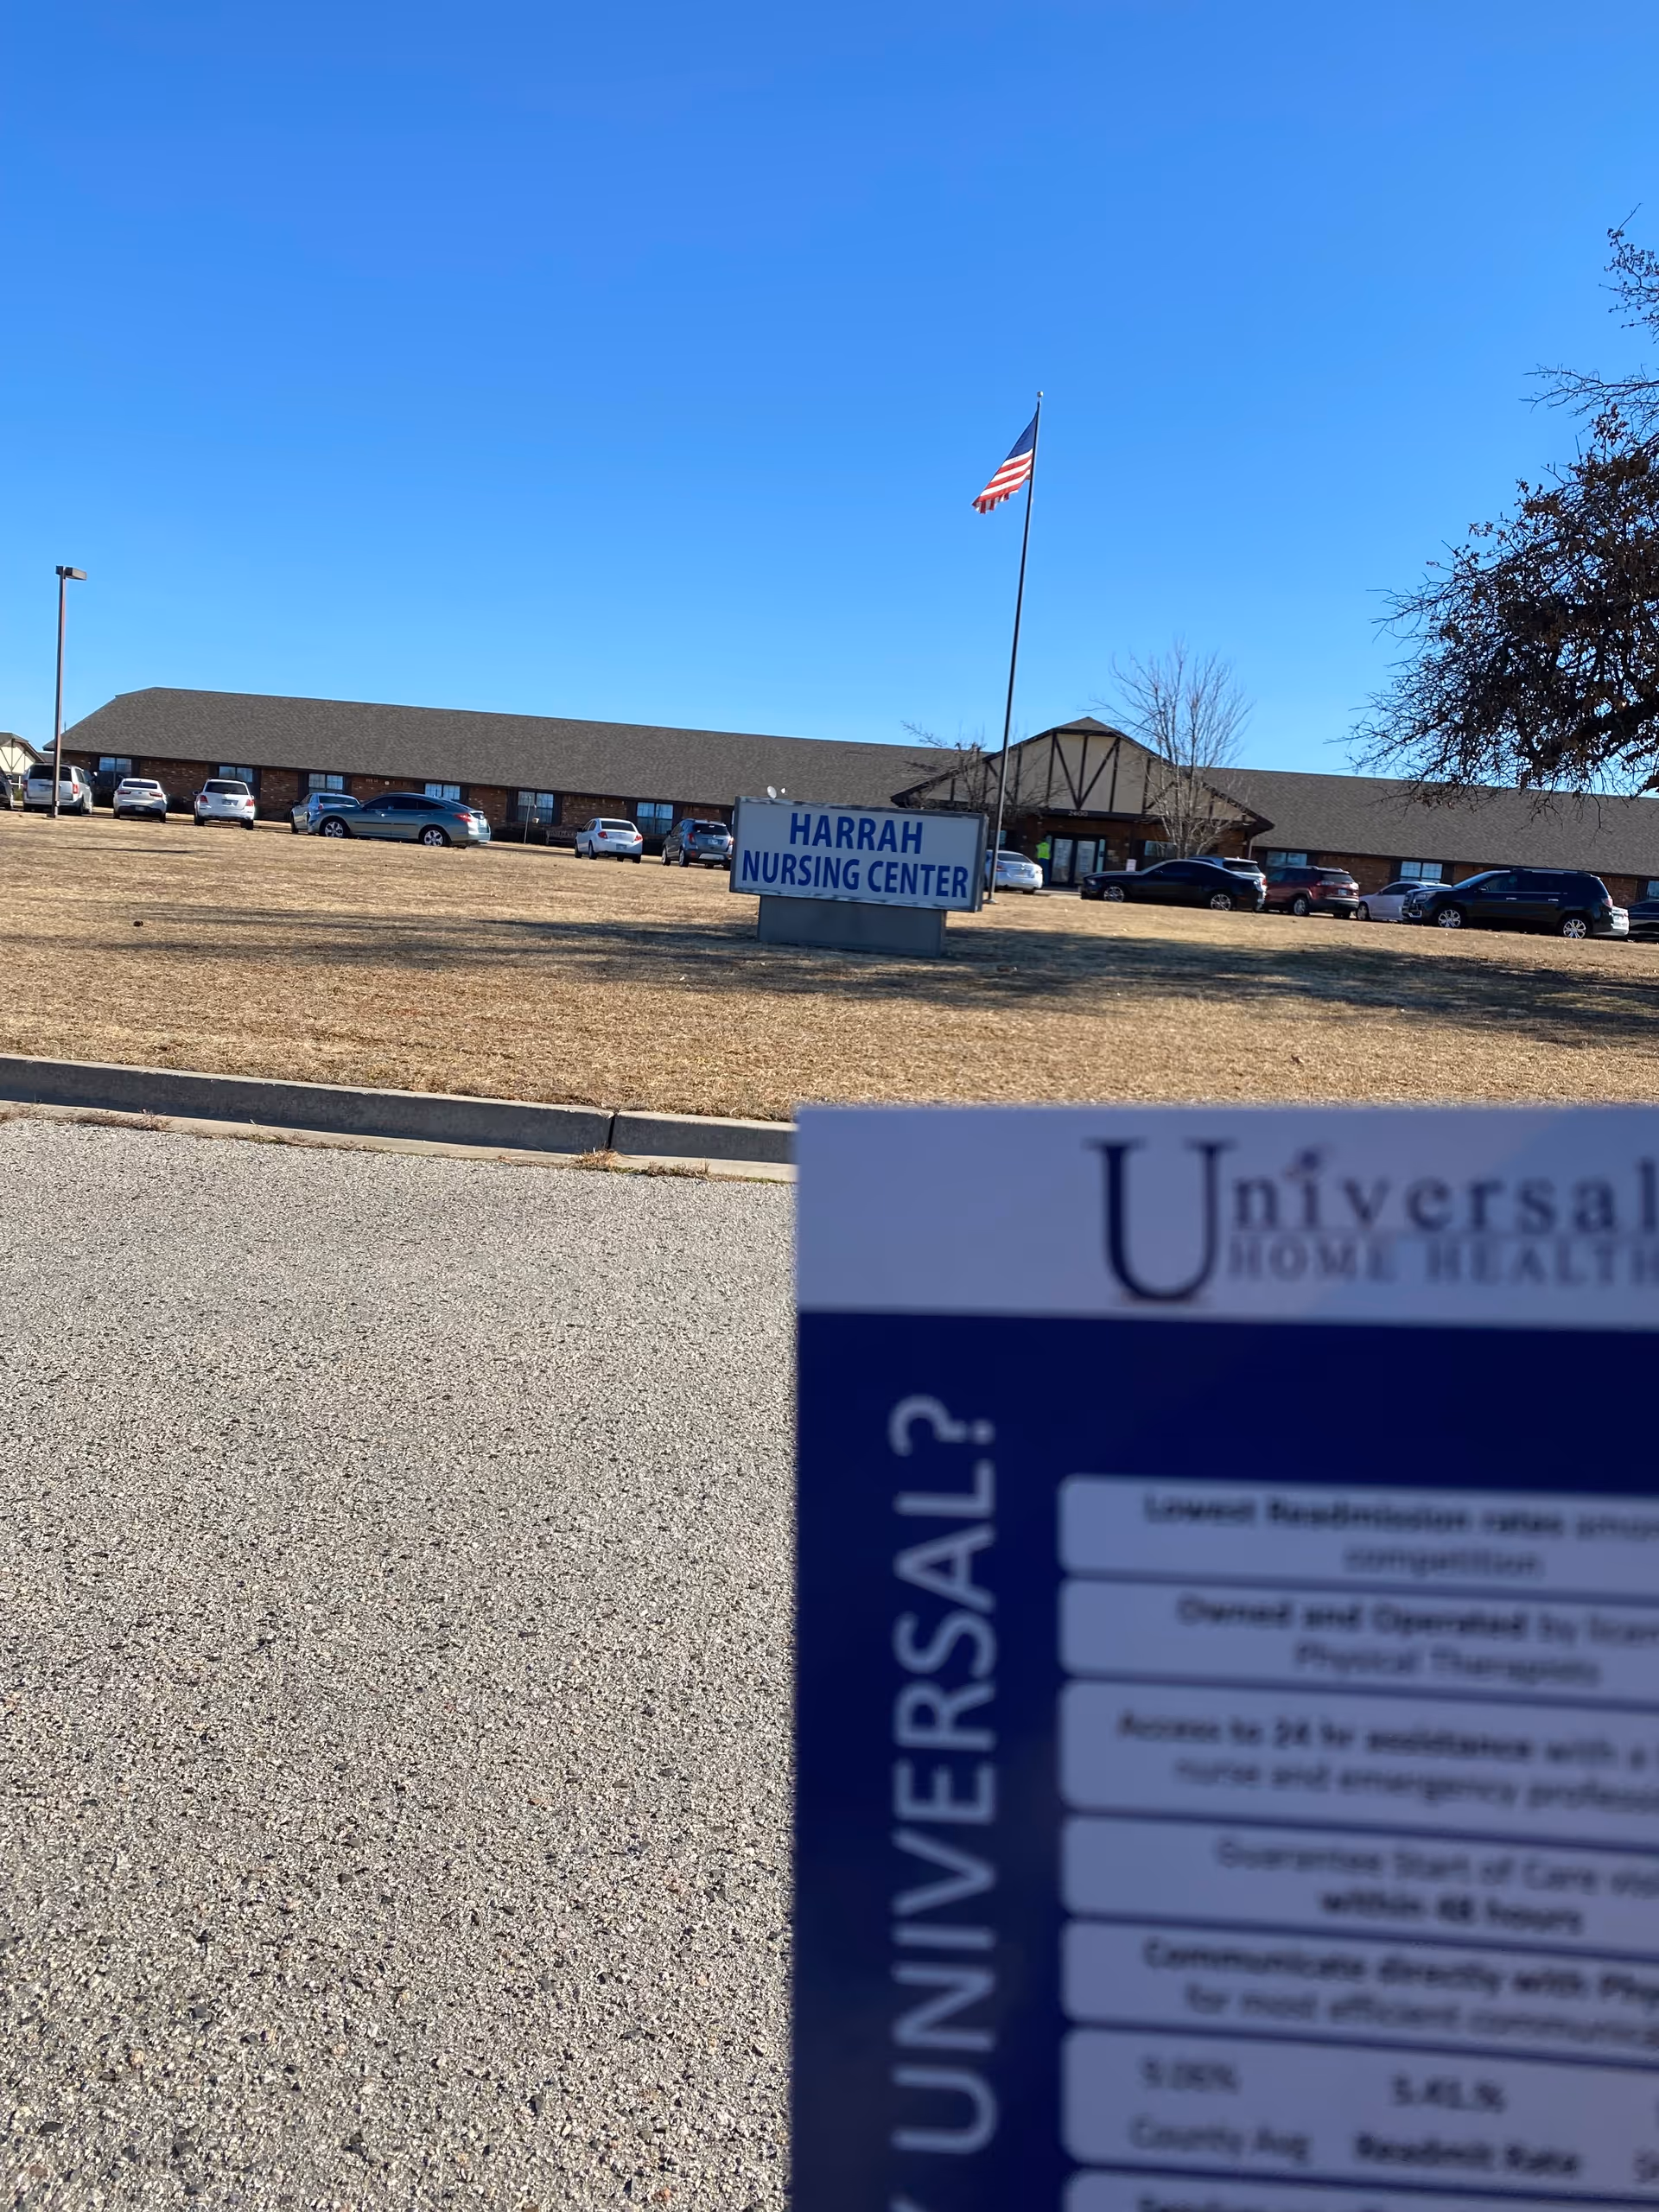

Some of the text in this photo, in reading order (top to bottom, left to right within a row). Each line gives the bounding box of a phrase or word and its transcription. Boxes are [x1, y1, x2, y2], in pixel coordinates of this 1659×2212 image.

[790, 812, 923, 855] HARRAH
[741, 849, 969, 899] NURSING CENTER
[1084, 1137, 1659, 1303] Universal
[1229, 1236, 1395, 1285] HOME
[1176, 1592, 1293, 1627] Owned
[1303, 1603, 1363, 1630] and
[888, 1394, 997, 2155] UNIVERSAL?
